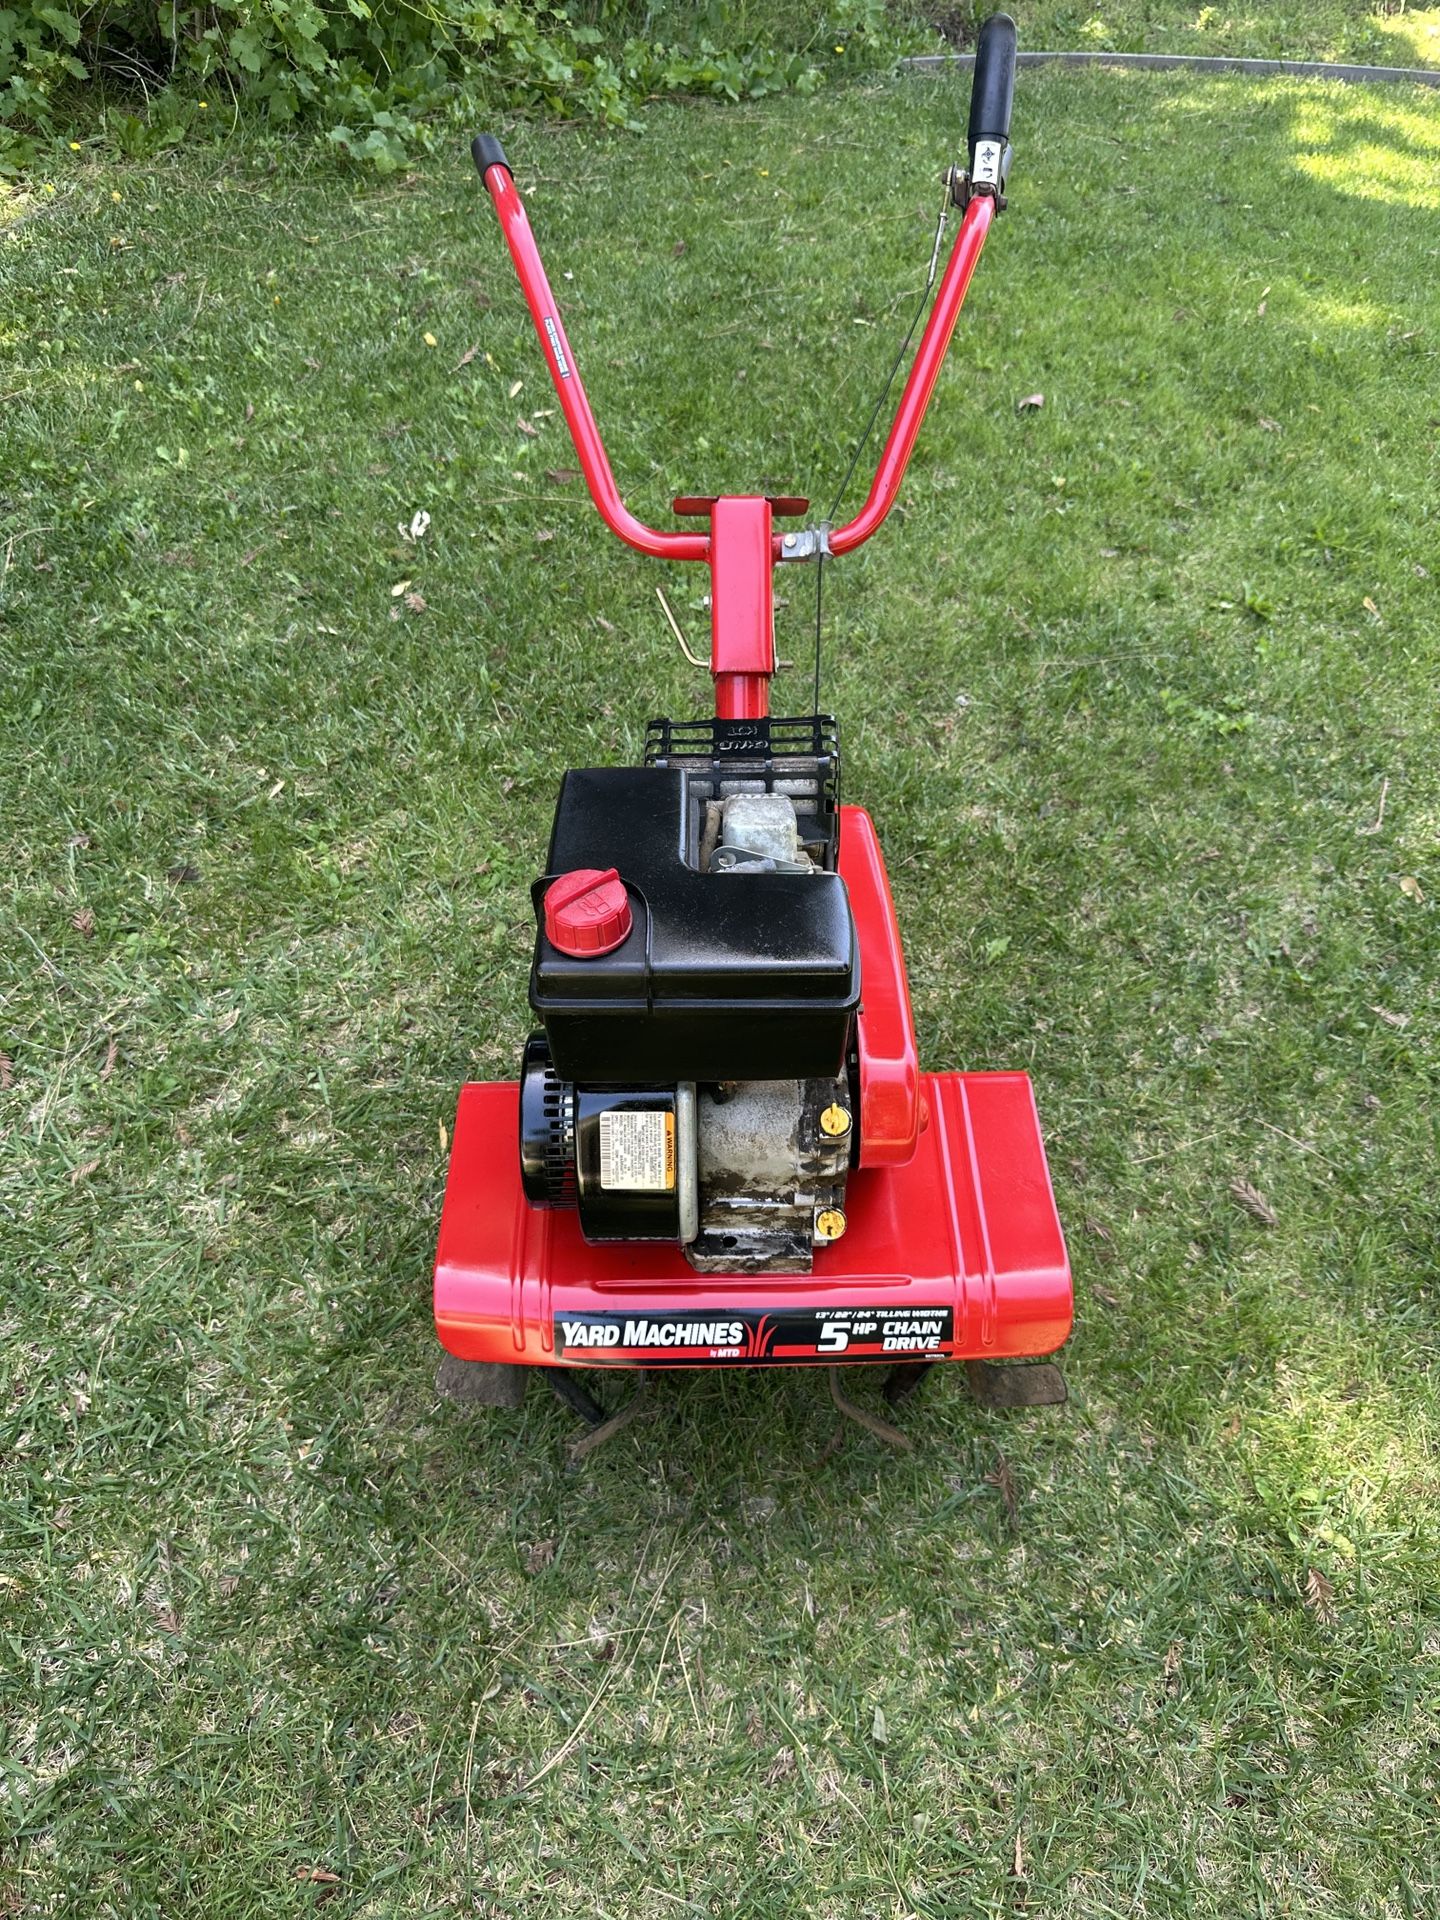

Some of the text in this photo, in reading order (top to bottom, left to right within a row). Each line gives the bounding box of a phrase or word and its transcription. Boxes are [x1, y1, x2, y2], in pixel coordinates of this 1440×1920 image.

[666, 1137, 674, 1172] WARNING
[876, 1310, 910, 1318] TILLING
[911, 1310, 948, 1318] WIDTHS
[562, 1320, 744, 1346] YARD MACHINES
[817, 1321, 942, 1352] 5 HP CHAIN
[717, 1349, 740, 1357] MTD
[882, 1336, 941, 1351] DRIVE
